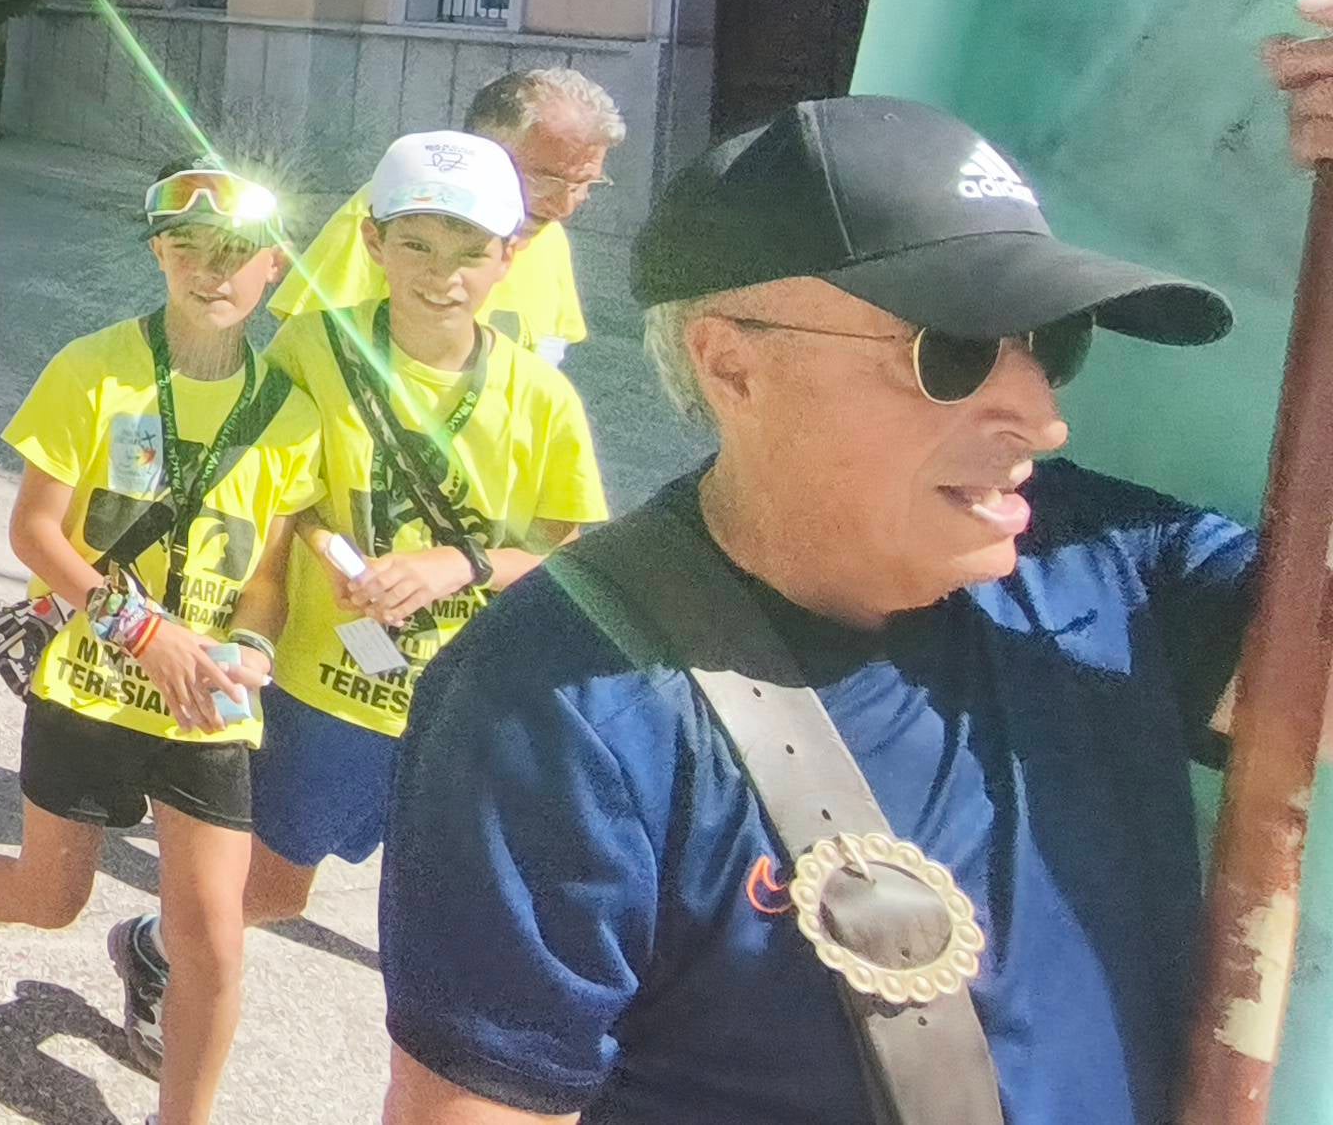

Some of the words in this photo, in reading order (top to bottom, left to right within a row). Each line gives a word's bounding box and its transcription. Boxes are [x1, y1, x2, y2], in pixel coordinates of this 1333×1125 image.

[958, 175, 1039, 206] adid
[180, 598, 227, 630] ÍRAM
[57, 656, 171, 716] TERESIA
[318, 663, 410, 714] TERES
